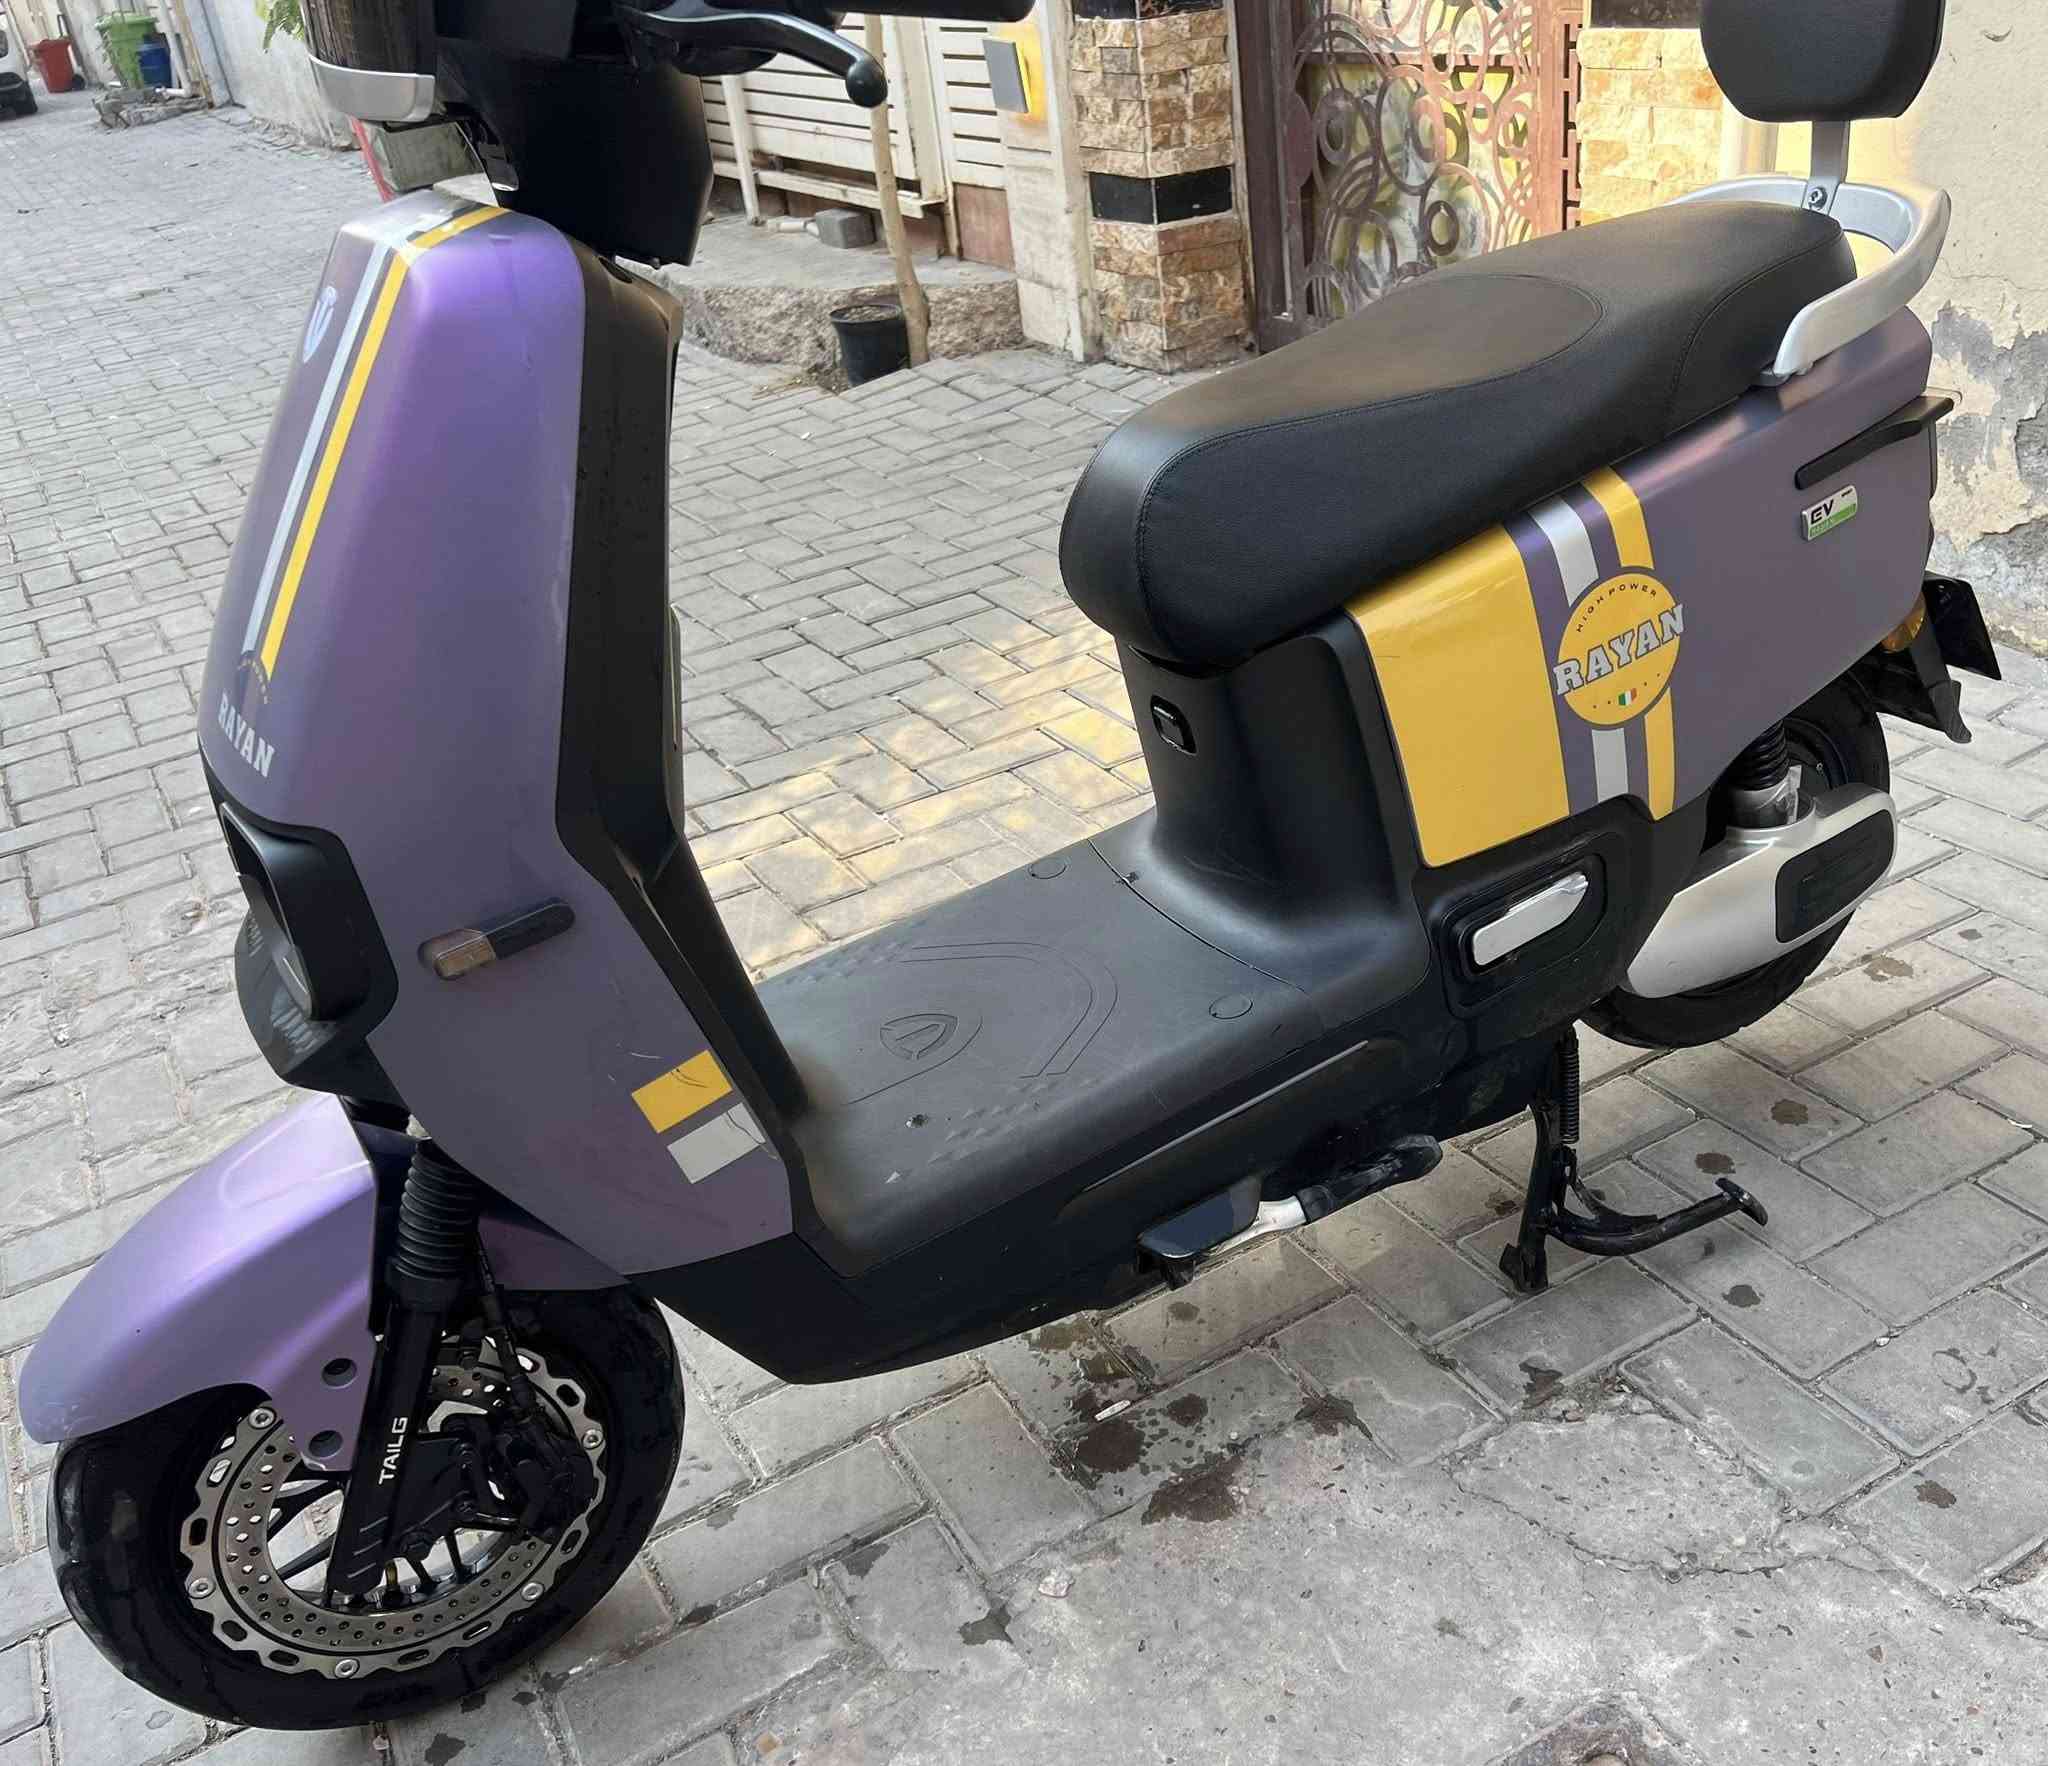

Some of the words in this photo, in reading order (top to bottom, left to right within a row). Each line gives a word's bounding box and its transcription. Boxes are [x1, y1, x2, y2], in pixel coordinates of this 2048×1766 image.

[1811, 499, 1834, 525] EV
[1608, 583, 1657, 597] POWER
[1553, 603, 1684, 696] RAYAN
[218, 690, 275, 778] RAYAN
[379, 1417, 408, 1485] TAILG
